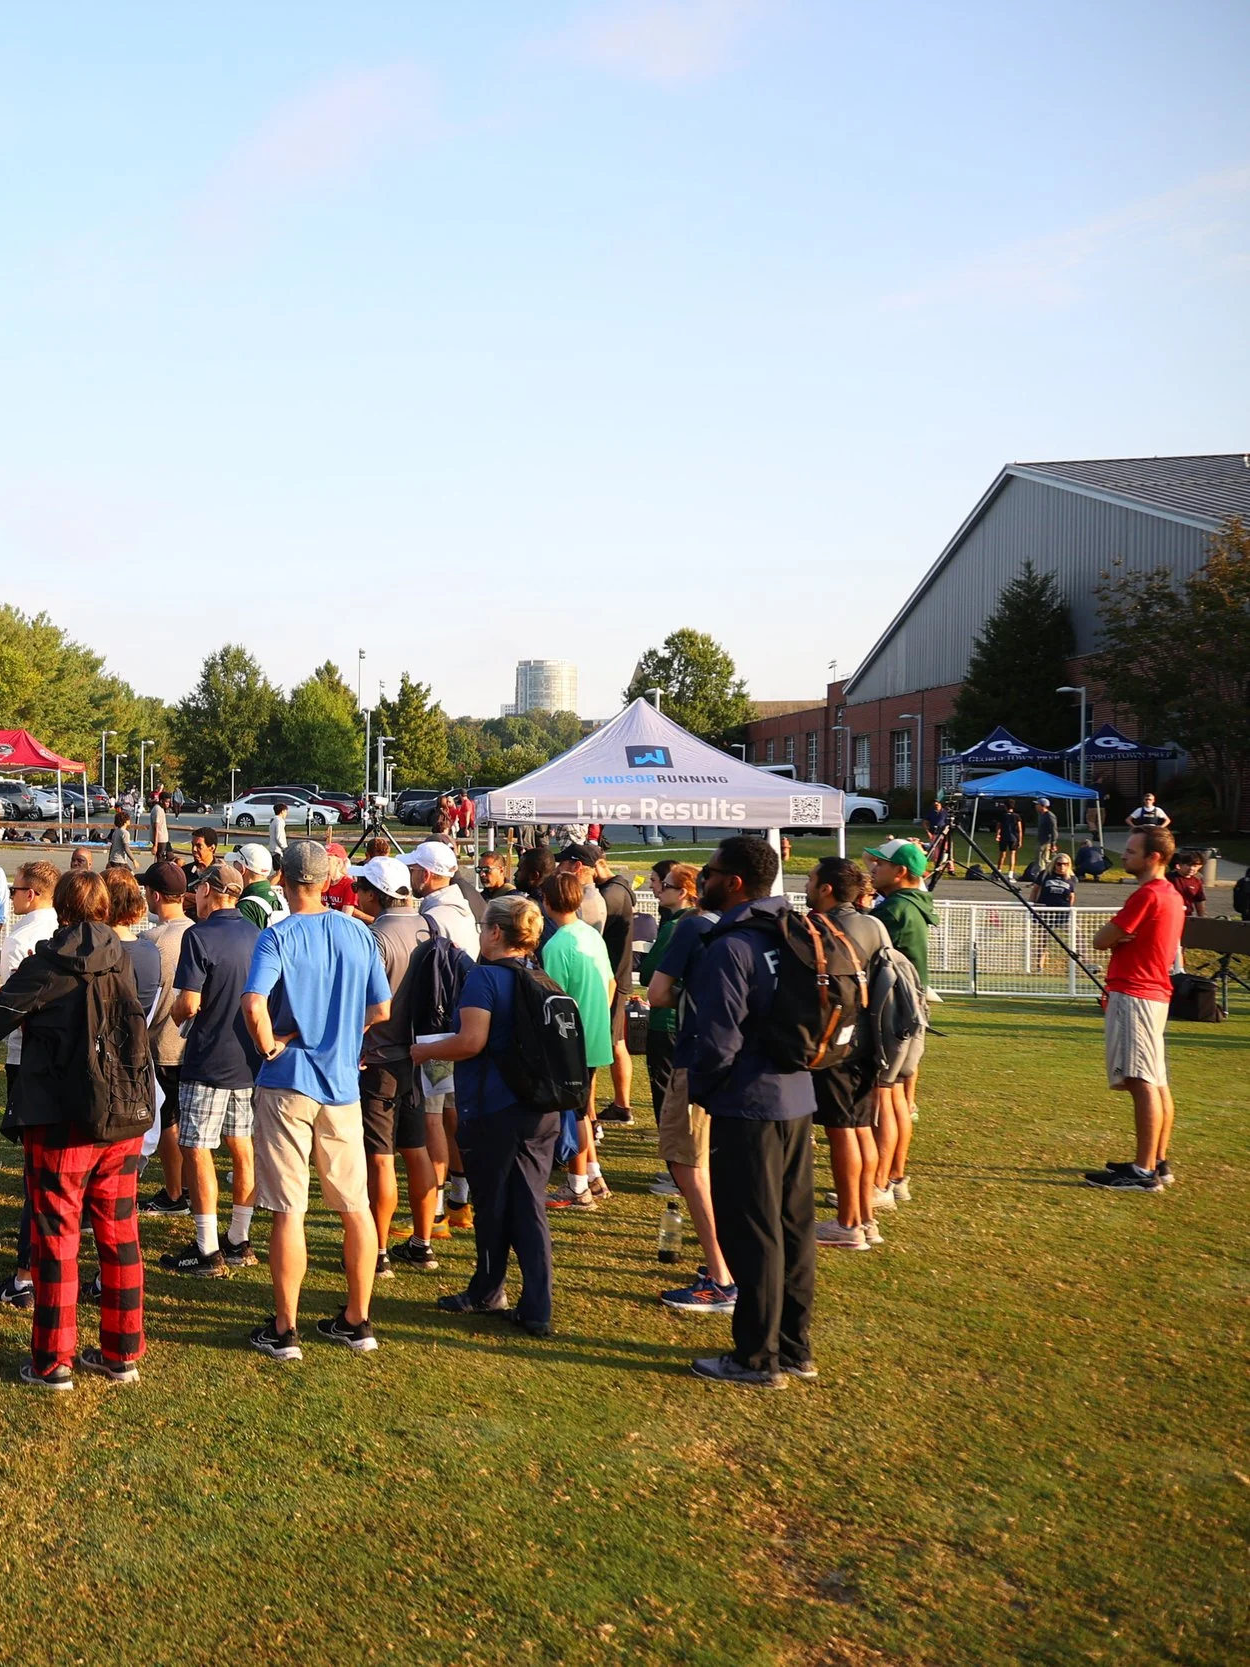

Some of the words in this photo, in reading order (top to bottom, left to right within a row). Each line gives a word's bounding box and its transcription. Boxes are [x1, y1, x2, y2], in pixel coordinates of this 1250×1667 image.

[582, 774, 729, 785] WINDSORRUNNING
[576, 798, 632, 820] Live
[640, 798, 747, 822] Results
[178, 1257, 199, 1267] HOKA
